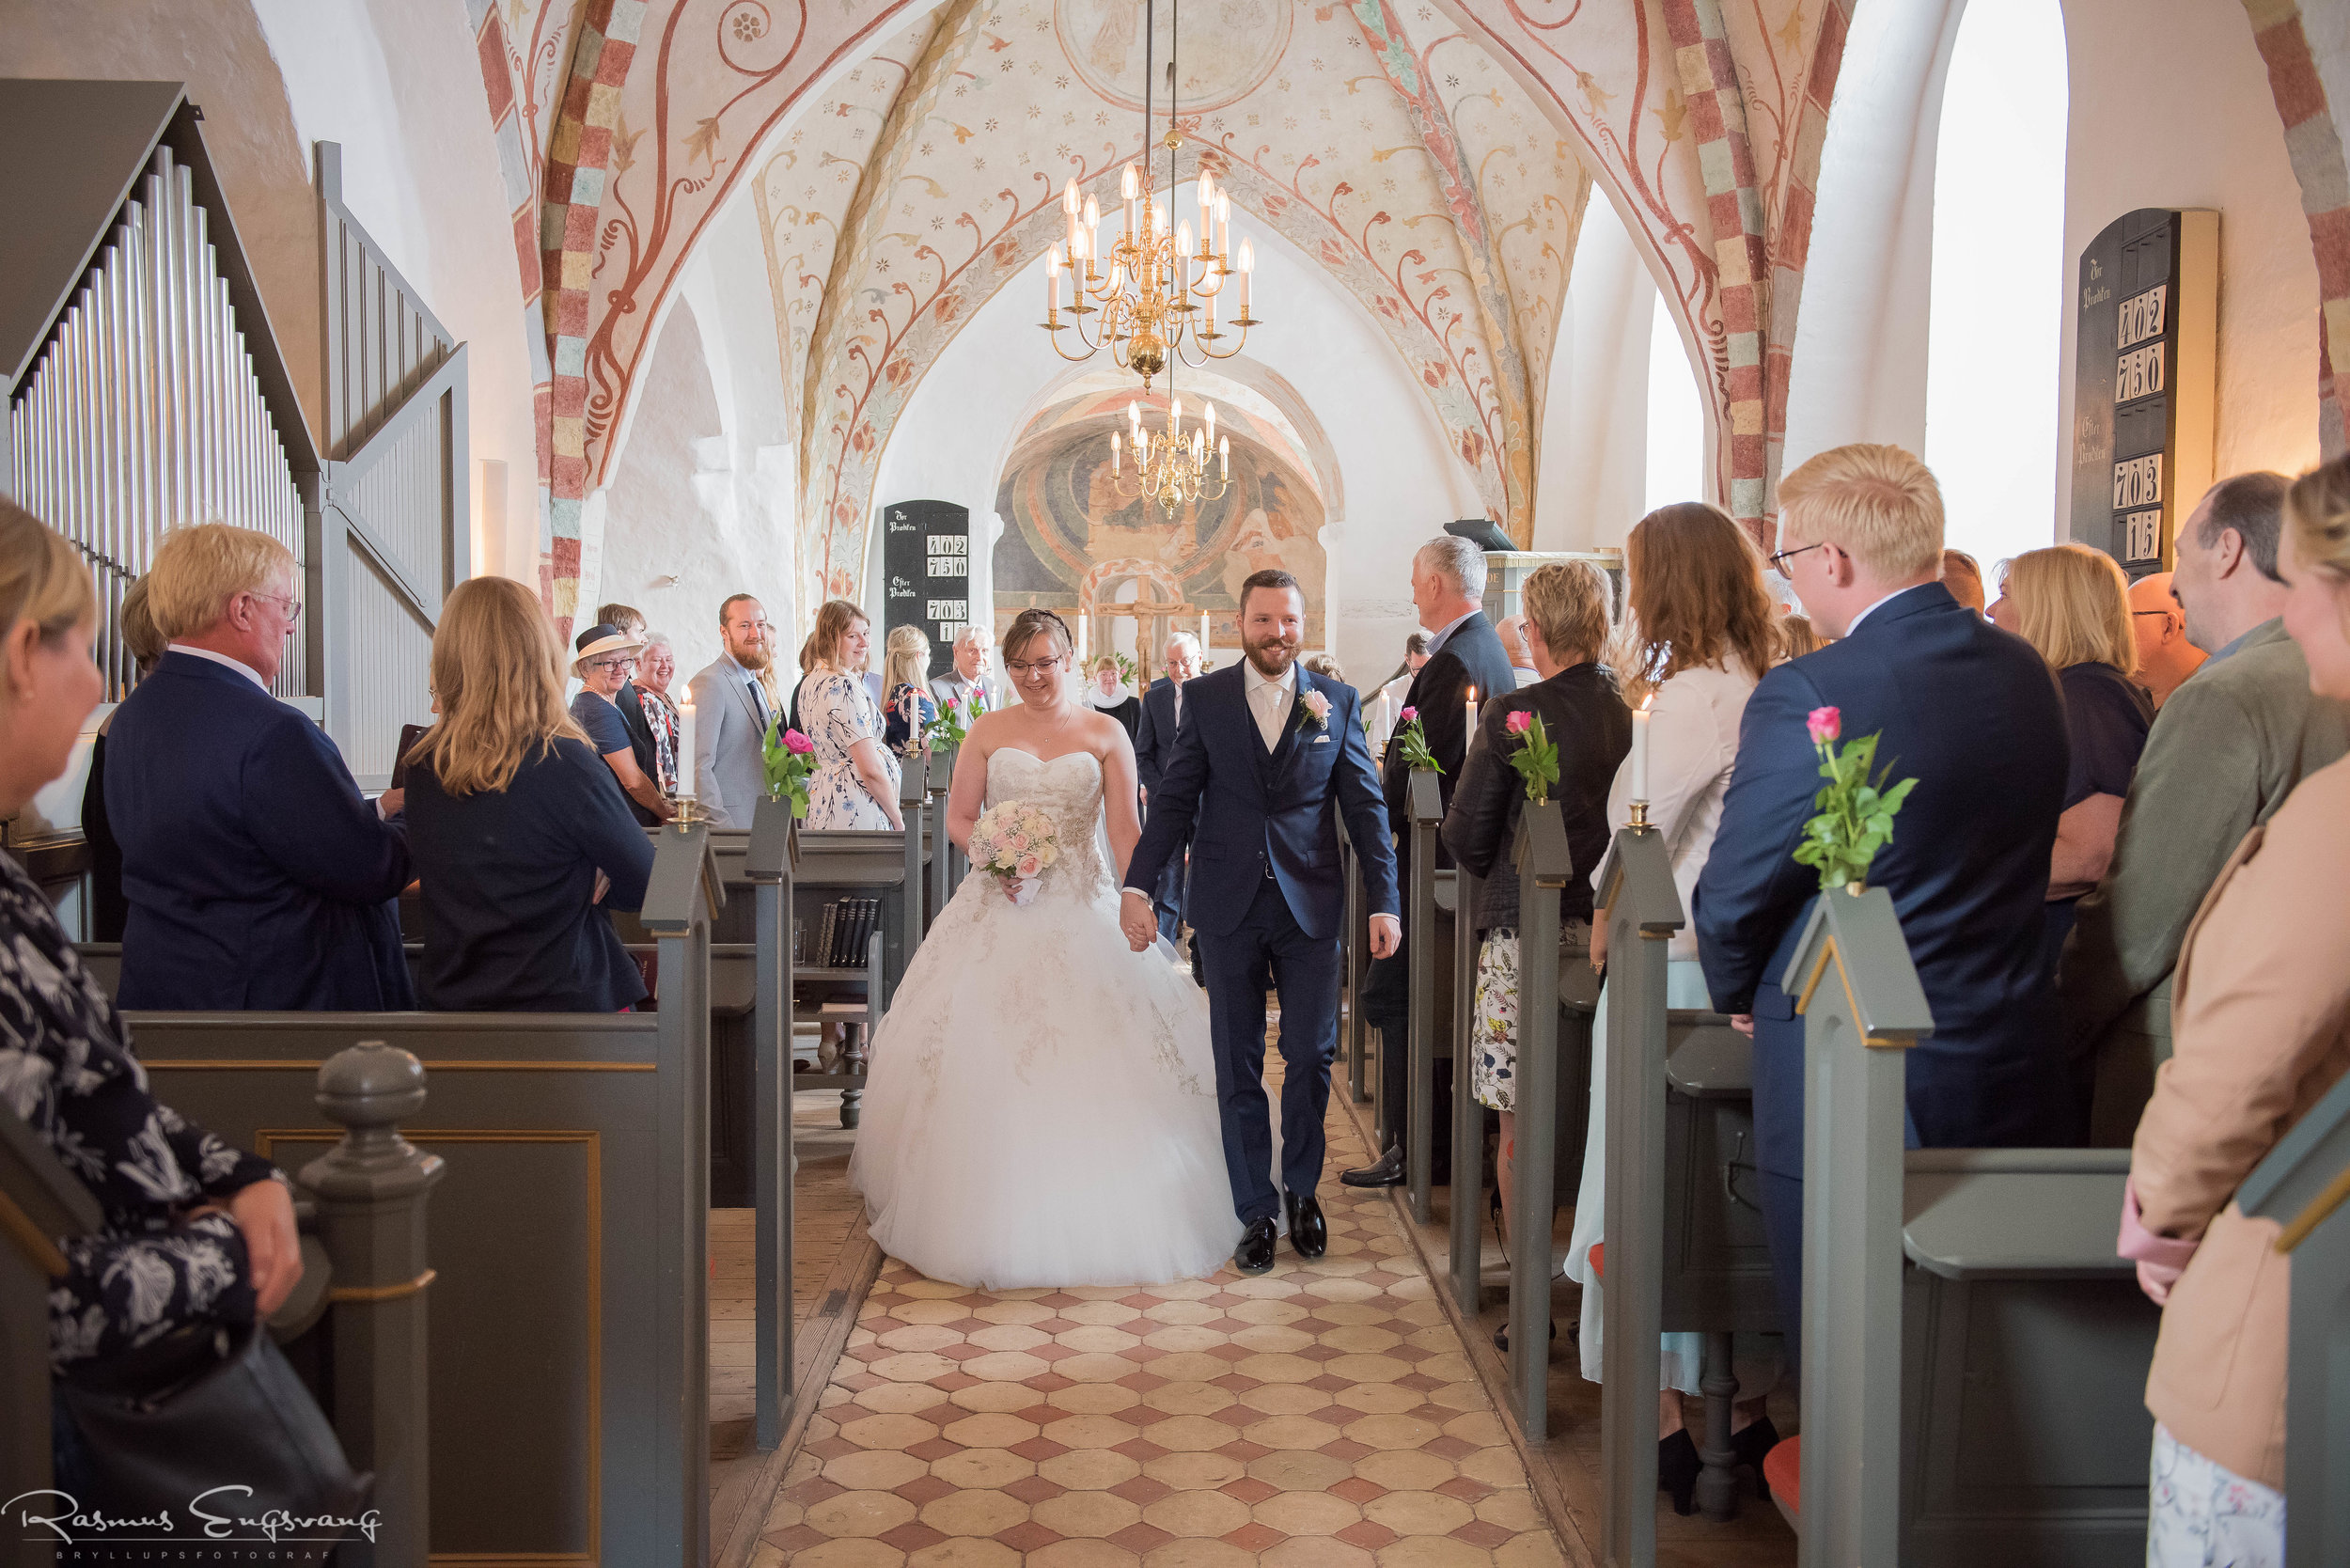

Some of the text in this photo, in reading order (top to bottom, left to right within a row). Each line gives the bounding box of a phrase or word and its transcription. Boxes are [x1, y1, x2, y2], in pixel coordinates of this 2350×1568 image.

[2120, 298, 2160, 346] 402
[2118, 354, 2159, 400] 750
[2116, 464, 2157, 507] 703
[930, 540, 965, 554] 402
[2129, 521, 2154, 558] 15
[930, 561, 964, 575] 750
[930, 604, 965, 619] 703
